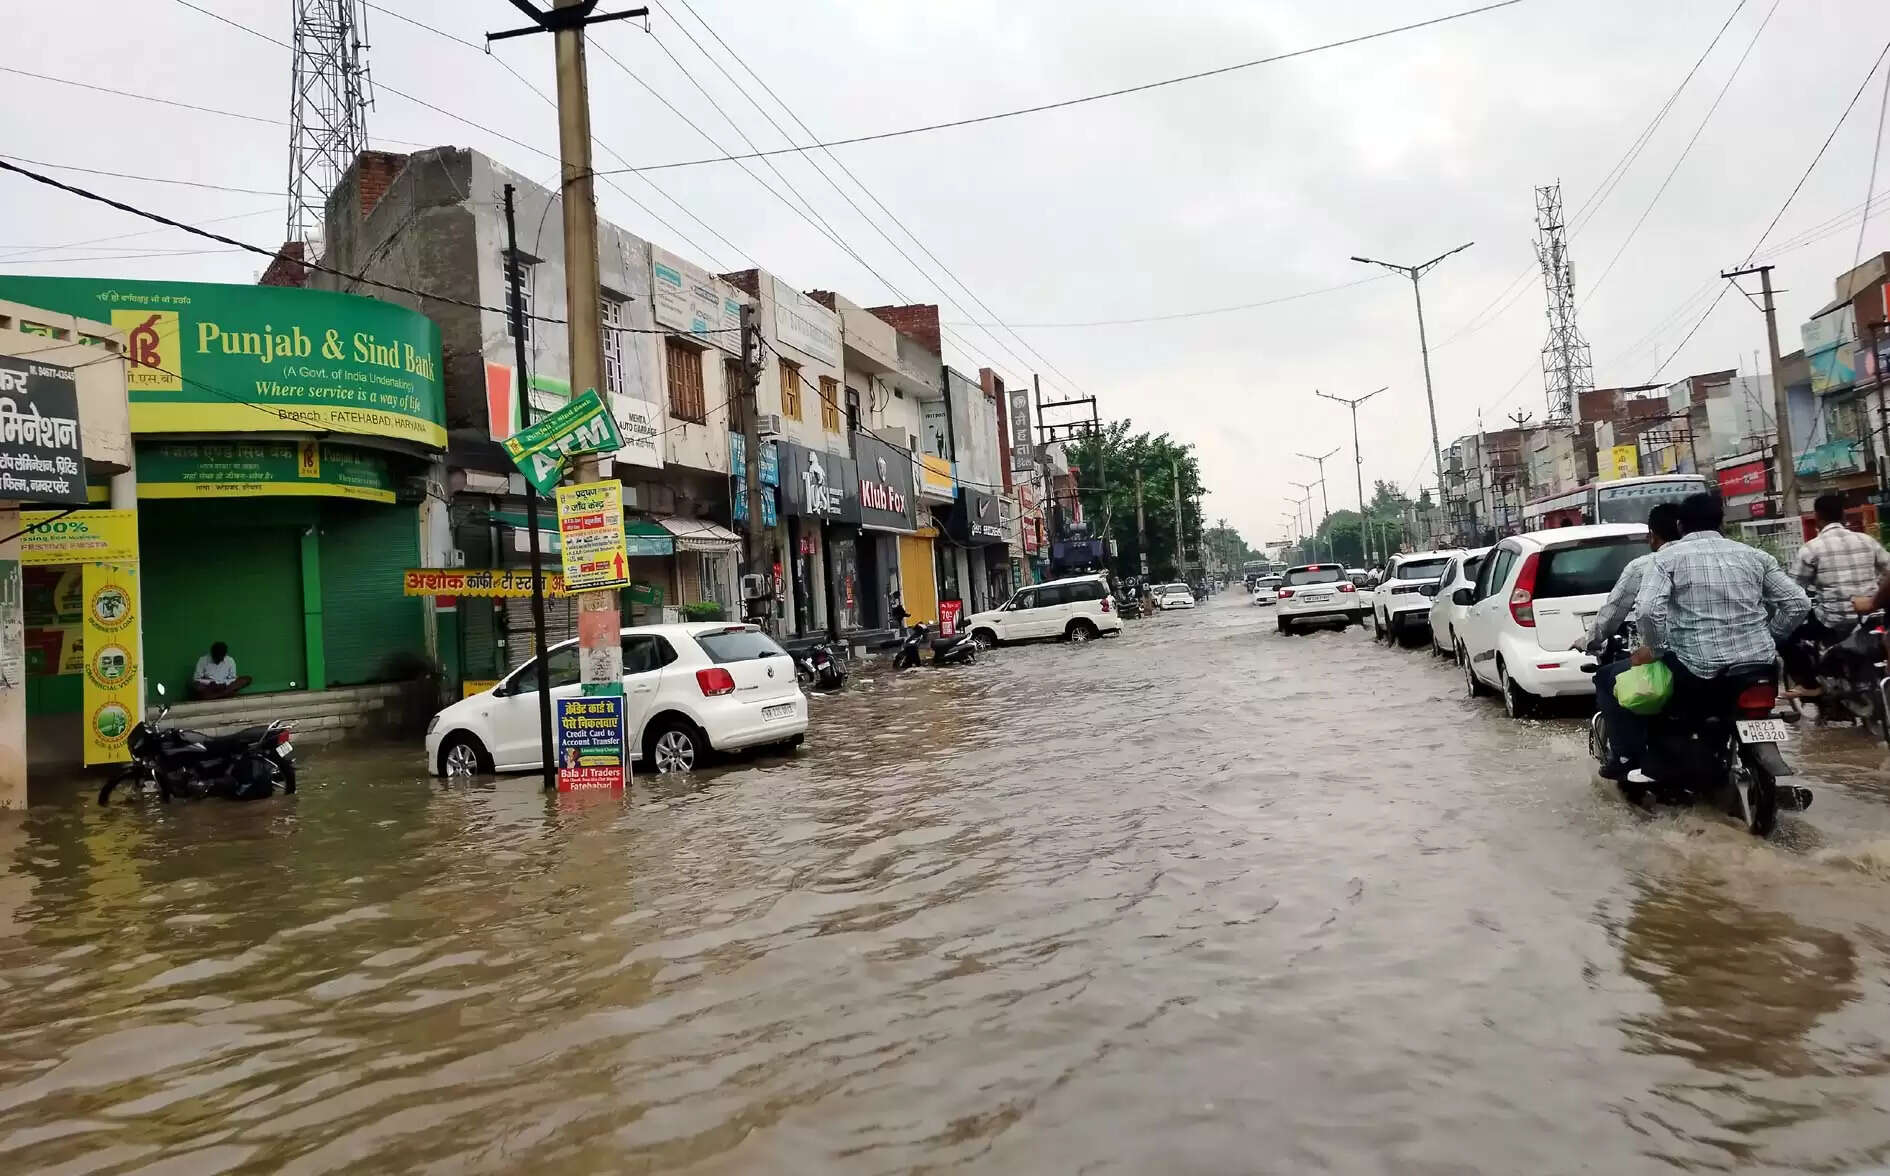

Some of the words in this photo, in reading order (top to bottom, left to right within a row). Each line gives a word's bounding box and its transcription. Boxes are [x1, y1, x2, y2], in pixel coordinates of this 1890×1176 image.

[196, 322, 311, 363] Punjab
[322, 329, 345, 360] &
[353, 332, 400, 369] Sind
[403, 343, 435, 382] Bank
[283, 366, 297, 377] (A
[299, 366, 328, 379] Govt.
[331, 369, 342, 381] of
[344, 370, 367, 383] India
[256, 382, 304, 397] Where
[308, 385, 354, 401] service
[357, 387, 367, 401] is
[370, 392, 377, 402] a
[379, 394, 398, 407] way
[399, 396, 409, 410] of
[279, 409, 320, 422] Branch
[394, 418, 427, 433] HARYANA
[531, 414, 611, 483] ATM
[860, 480, 887, 510] Klub
[888, 486, 904, 512] Fox
[1607, 483, 1700, 499] Friends
[26, 522, 88, 534] 100%
[407, 570, 465, 590] अशोक
[501, 570, 512, 590] टी
[589, 700, 605, 713] कार्ड
[566, 729, 587, 738] Credit
[589, 729, 605, 737] Card
[1748, 721, 1775, 731] HR23
[562, 738, 590, 746] Account
[592, 737, 620, 745] Transfer
[1751, 731, 1785, 741] H9320
[561, 769, 579, 778] Bala
[590, 768, 620, 777] Traders
